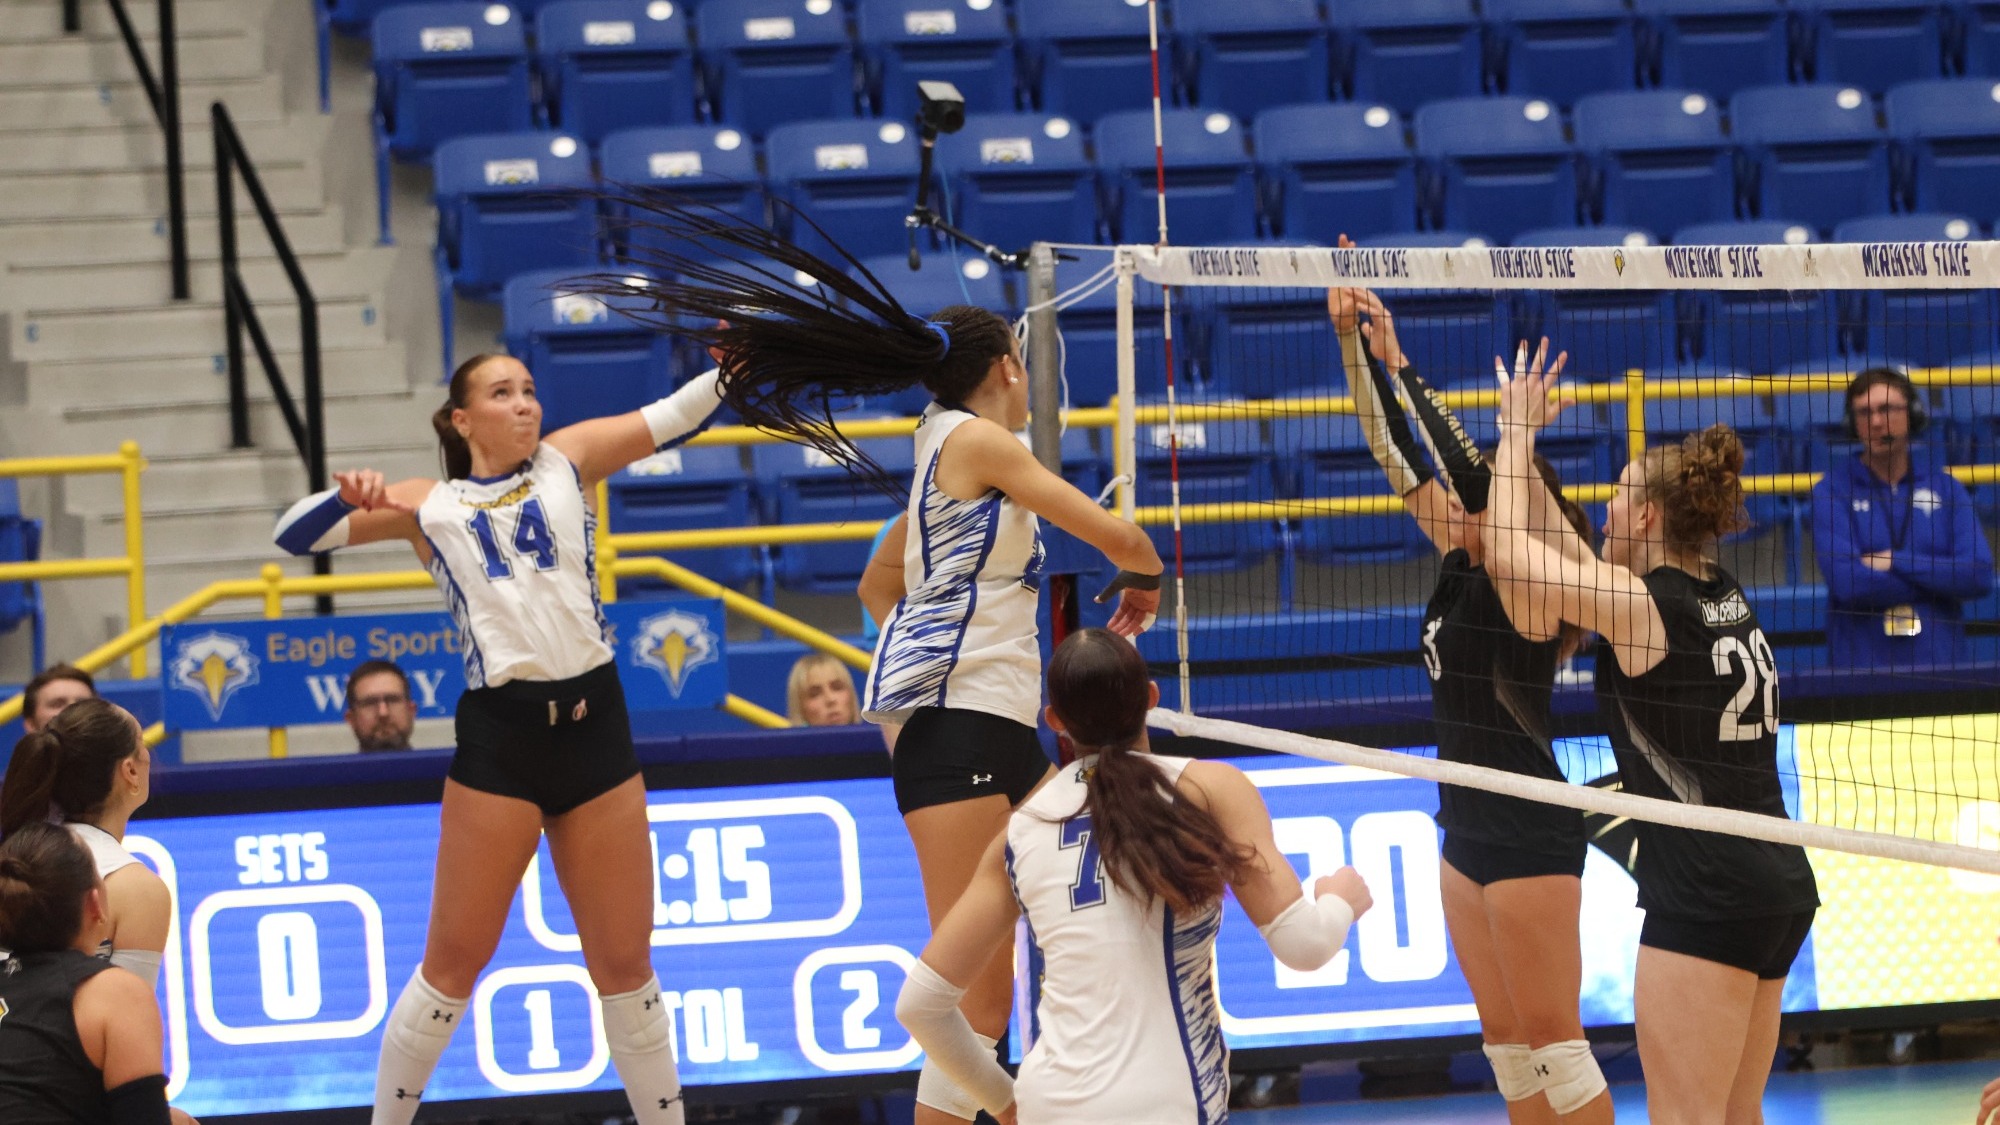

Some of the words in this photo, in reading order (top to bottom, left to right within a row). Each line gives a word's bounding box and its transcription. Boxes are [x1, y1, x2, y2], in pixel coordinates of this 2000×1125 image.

[466, 494, 560, 583] 14
[266, 629, 356, 668] Eagle
[1711, 627, 1780, 742] 28
[234, 831, 329, 885] SETS
[1058, 810, 1107, 913] 7
[257, 911, 323, 1021] 0
[524, 989, 561, 1070] 1
[839, 969, 882, 1050] 2
